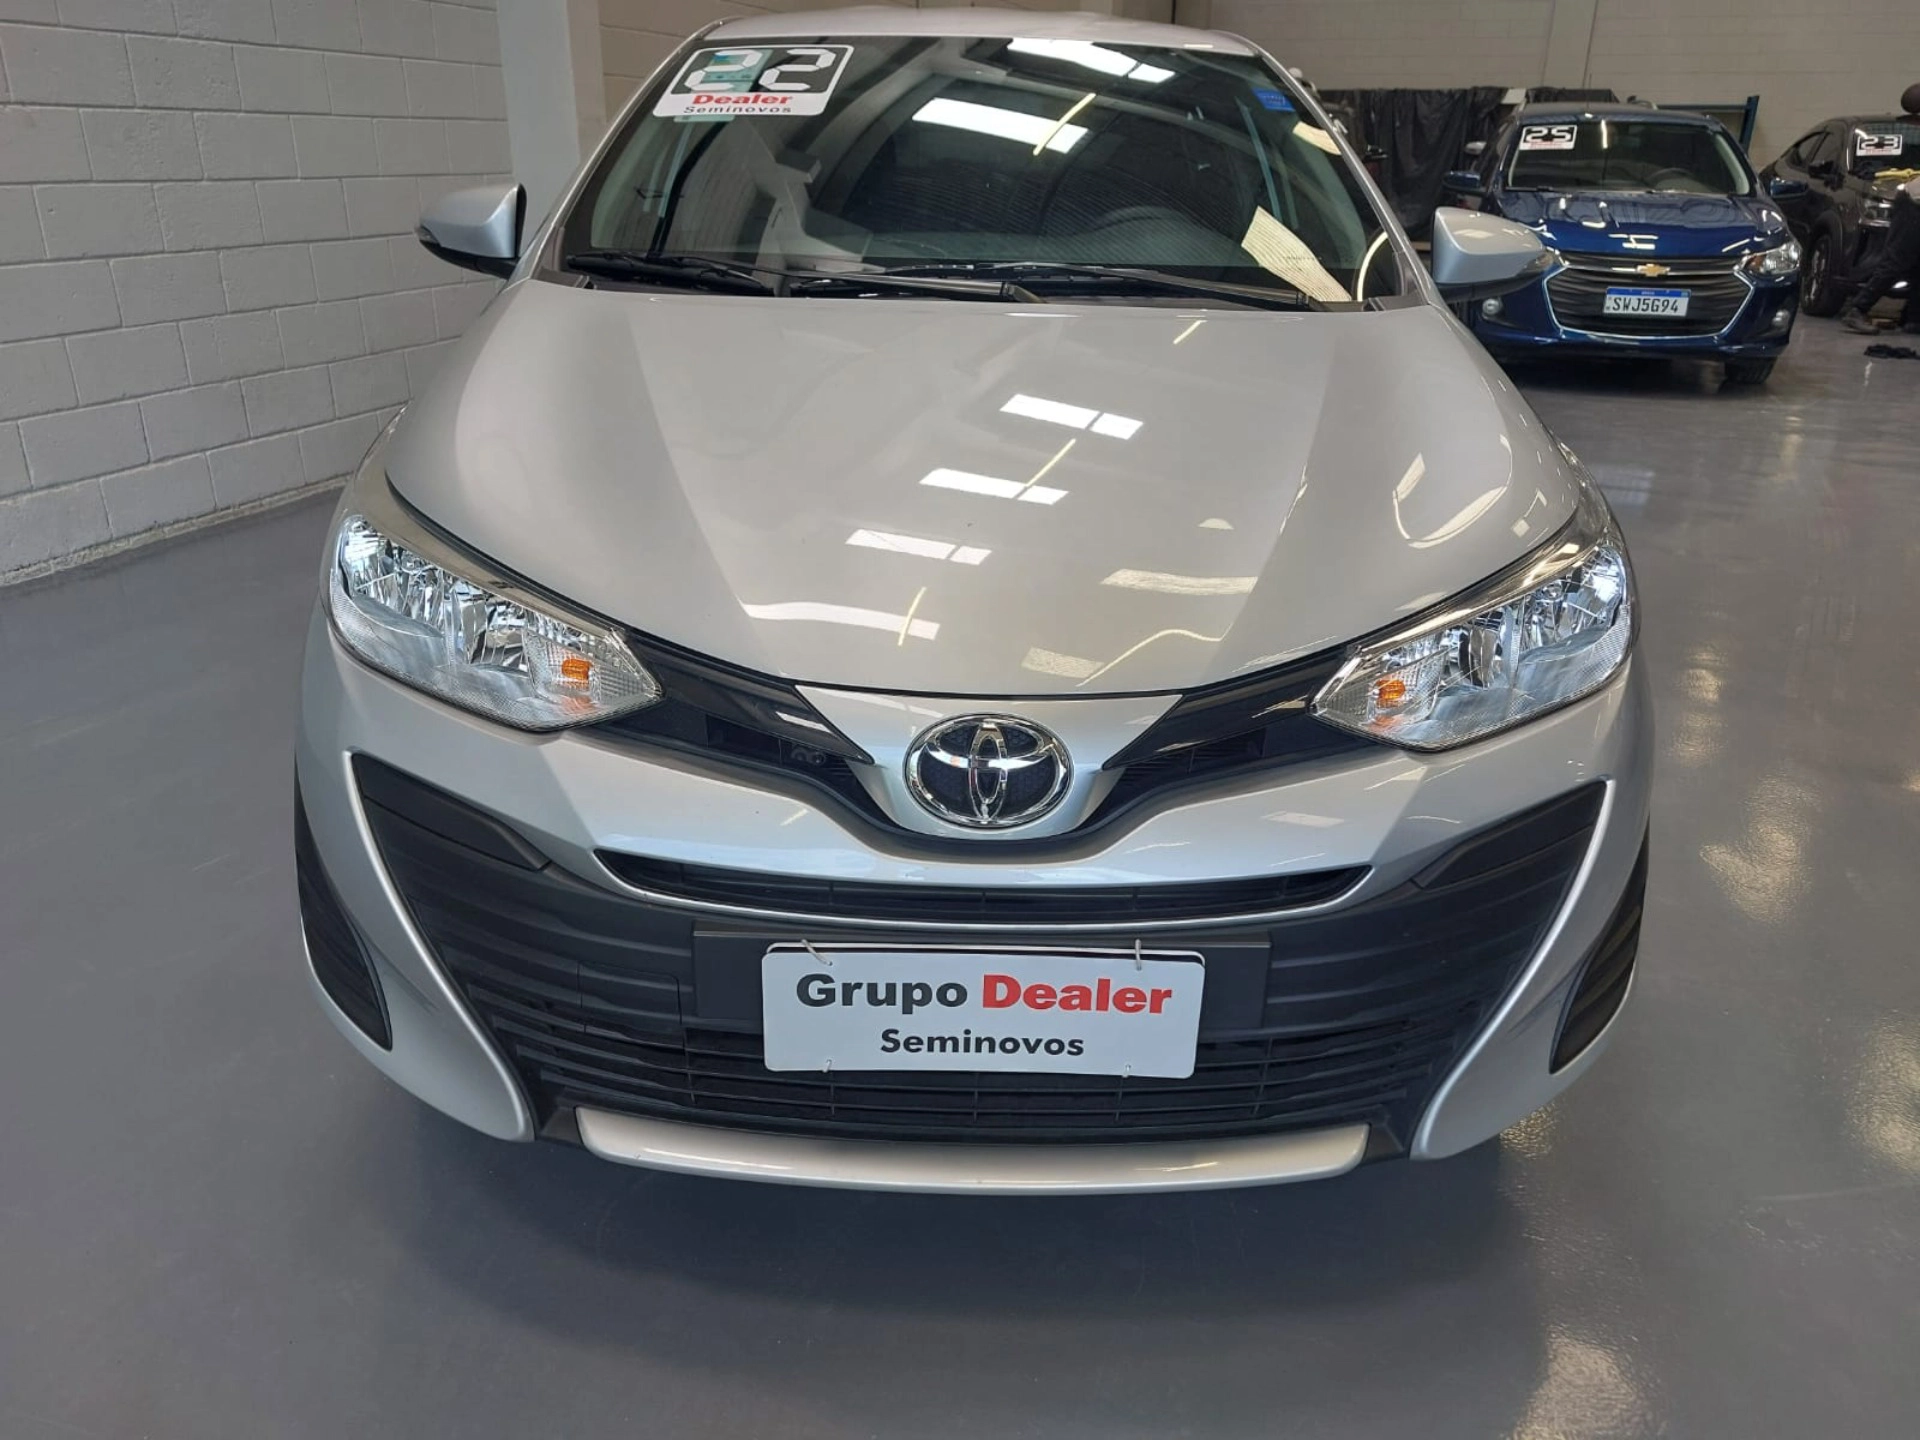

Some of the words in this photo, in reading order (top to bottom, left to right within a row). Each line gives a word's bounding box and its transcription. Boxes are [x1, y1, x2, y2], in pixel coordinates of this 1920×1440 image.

[683, 48, 837, 91] 22
[692, 94, 791, 105] Dealer
[683, 105, 792, 114] Seminovos
[1526, 126, 1571, 142] 25
[1860, 136, 1899, 150] 23
[1612, 297, 1679, 313] SWJ5G94
[796, 973, 968, 1014] Grupo
[982, 974, 1173, 1014] Dealer
[880, 1028, 1085, 1057] Seminovos
